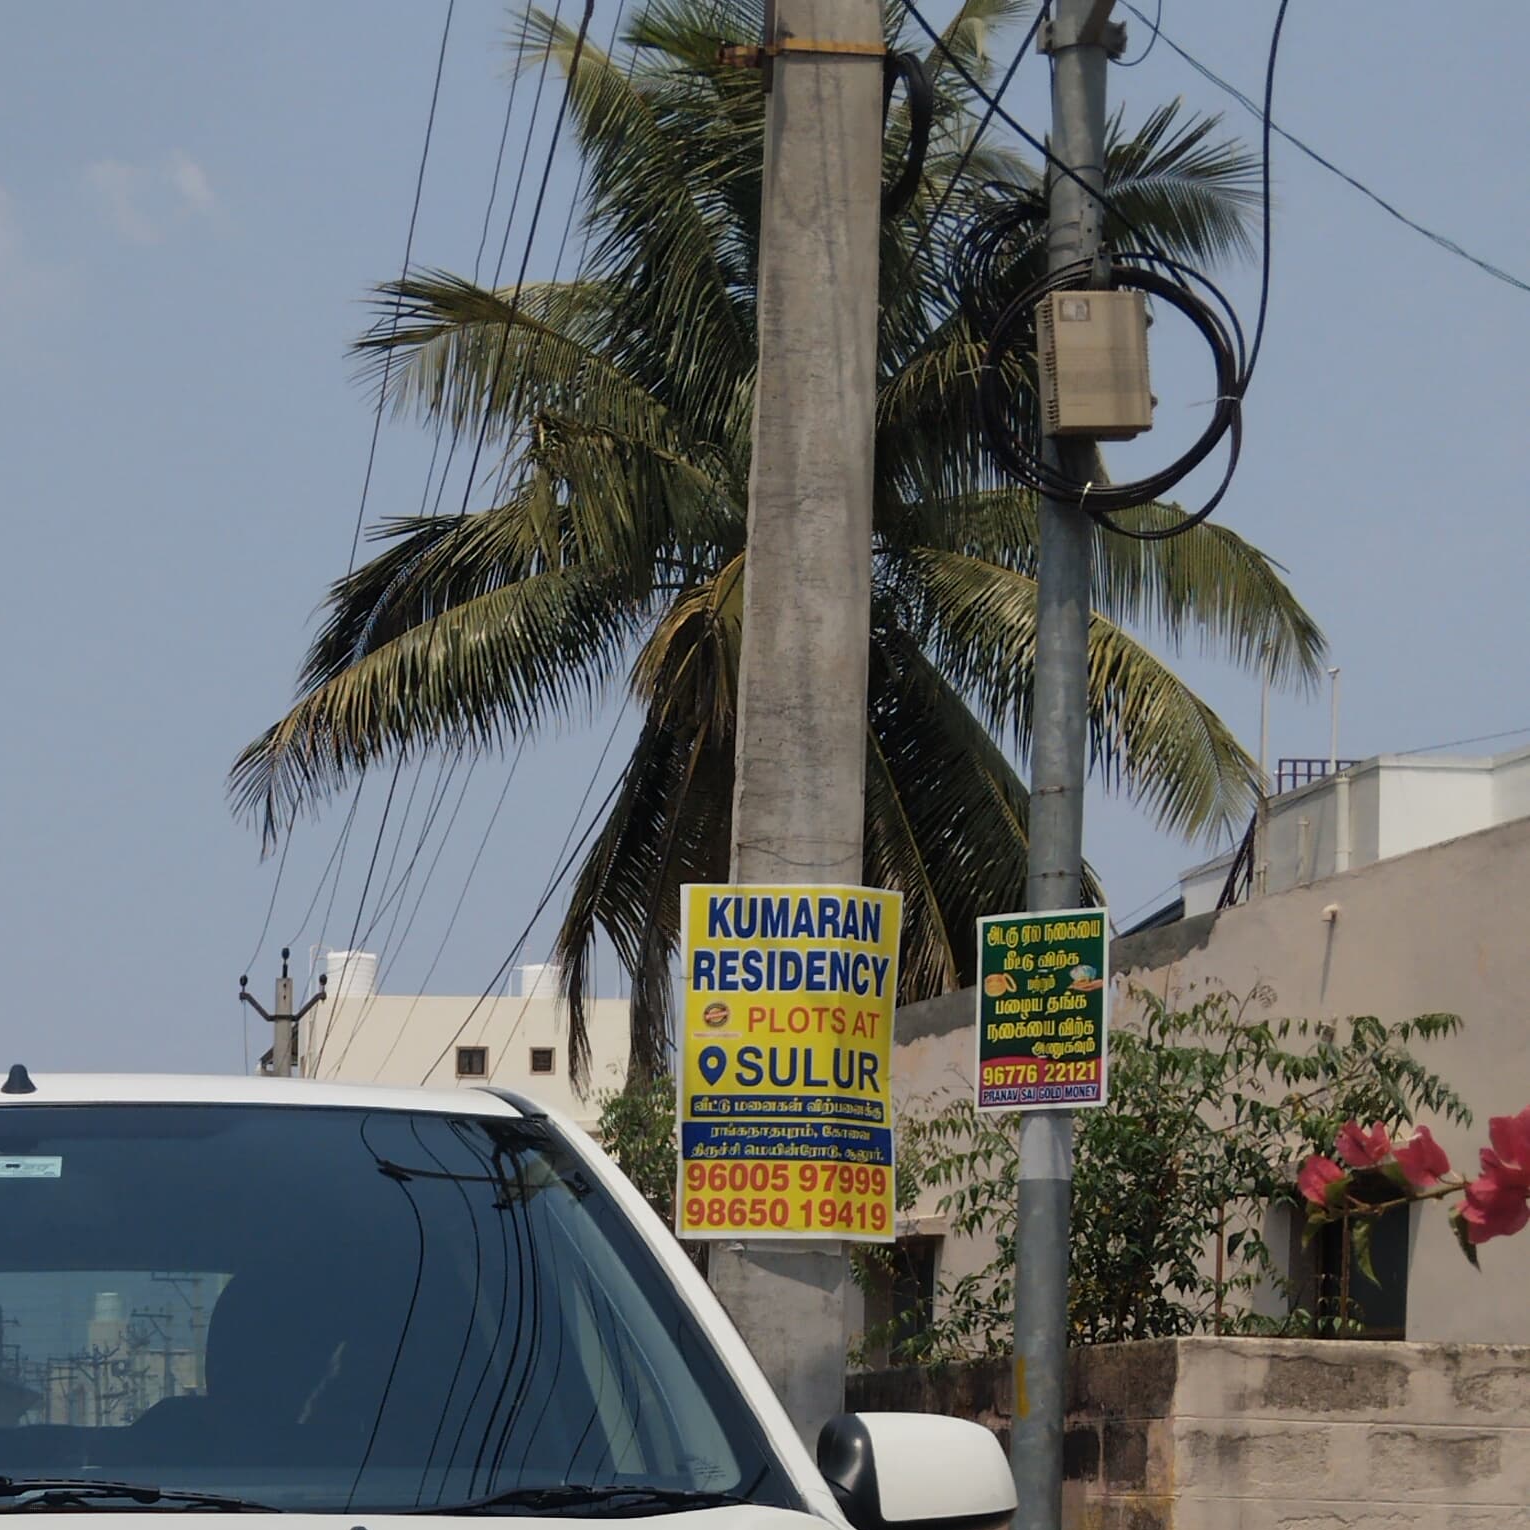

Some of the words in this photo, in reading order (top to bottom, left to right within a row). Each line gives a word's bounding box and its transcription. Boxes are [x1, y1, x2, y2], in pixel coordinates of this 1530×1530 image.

[708, 896, 881, 943] KUMARAN
[1044, 920, 1101, 944] நகையை
[692, 950, 890, 997] RESIDENCY
[995, 997, 1043, 1019] பழைய
[1045, 991, 1087, 1015] தங்க
[748, 1007, 847, 1035] PLOTS
[851, 1012, 880, 1039] AT
[987, 1020, 1055, 1043] நகையை
[735, 1046, 880, 1092] SULUR
[982, 1064, 1038, 1086] 96776
[1043, 1061, 1097, 1083] 22121
[983, 1088, 1019, 1103] PRANAV
[1020, 1087, 1037, 1102] SAI
[1038, 1085, 1062, 1101] GOLD
[1064, 1084, 1098, 1099] MONEY
[687, 1163, 790, 1192] 96005
[798, 1164, 887, 1196] 97999
[686, 1198, 790, 1226] 98650
[799, 1198, 887, 1231] 19419
